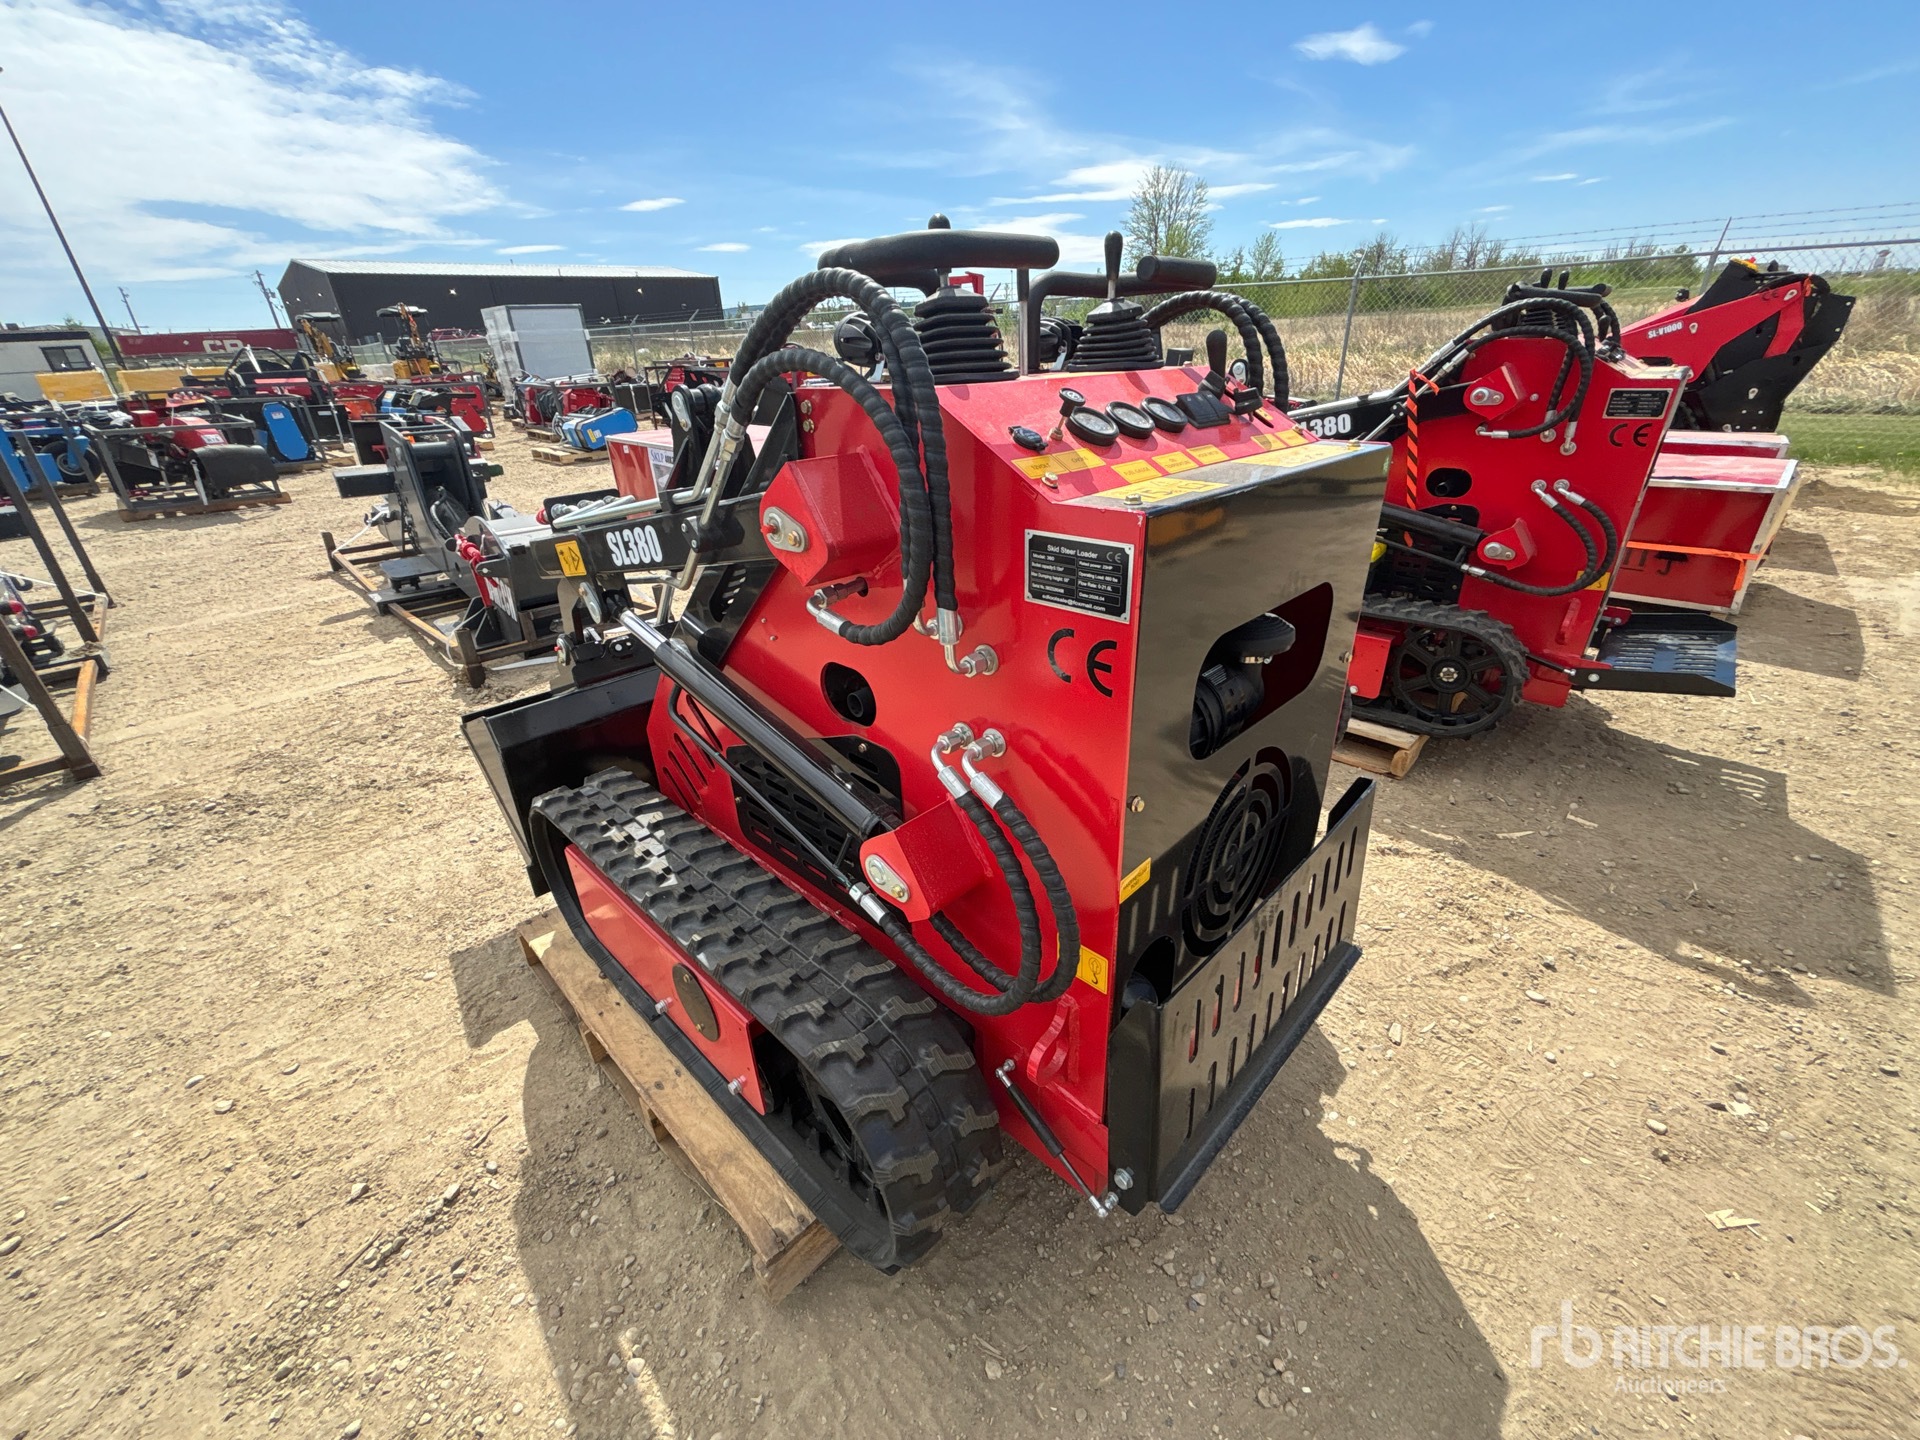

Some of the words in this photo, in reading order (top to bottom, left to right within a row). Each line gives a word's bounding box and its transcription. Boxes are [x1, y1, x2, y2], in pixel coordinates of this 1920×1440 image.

[1647, 321, 1683, 339] SL-V1000
[1609, 423, 1652, 448] CE
[605, 524, 663, 567] SL380
[1047, 544, 1060, 553] Skid
[1060, 546, 1077, 555] Steer
[1076, 549, 1099, 559] Loader
[1047, 627, 1118, 699] CE
